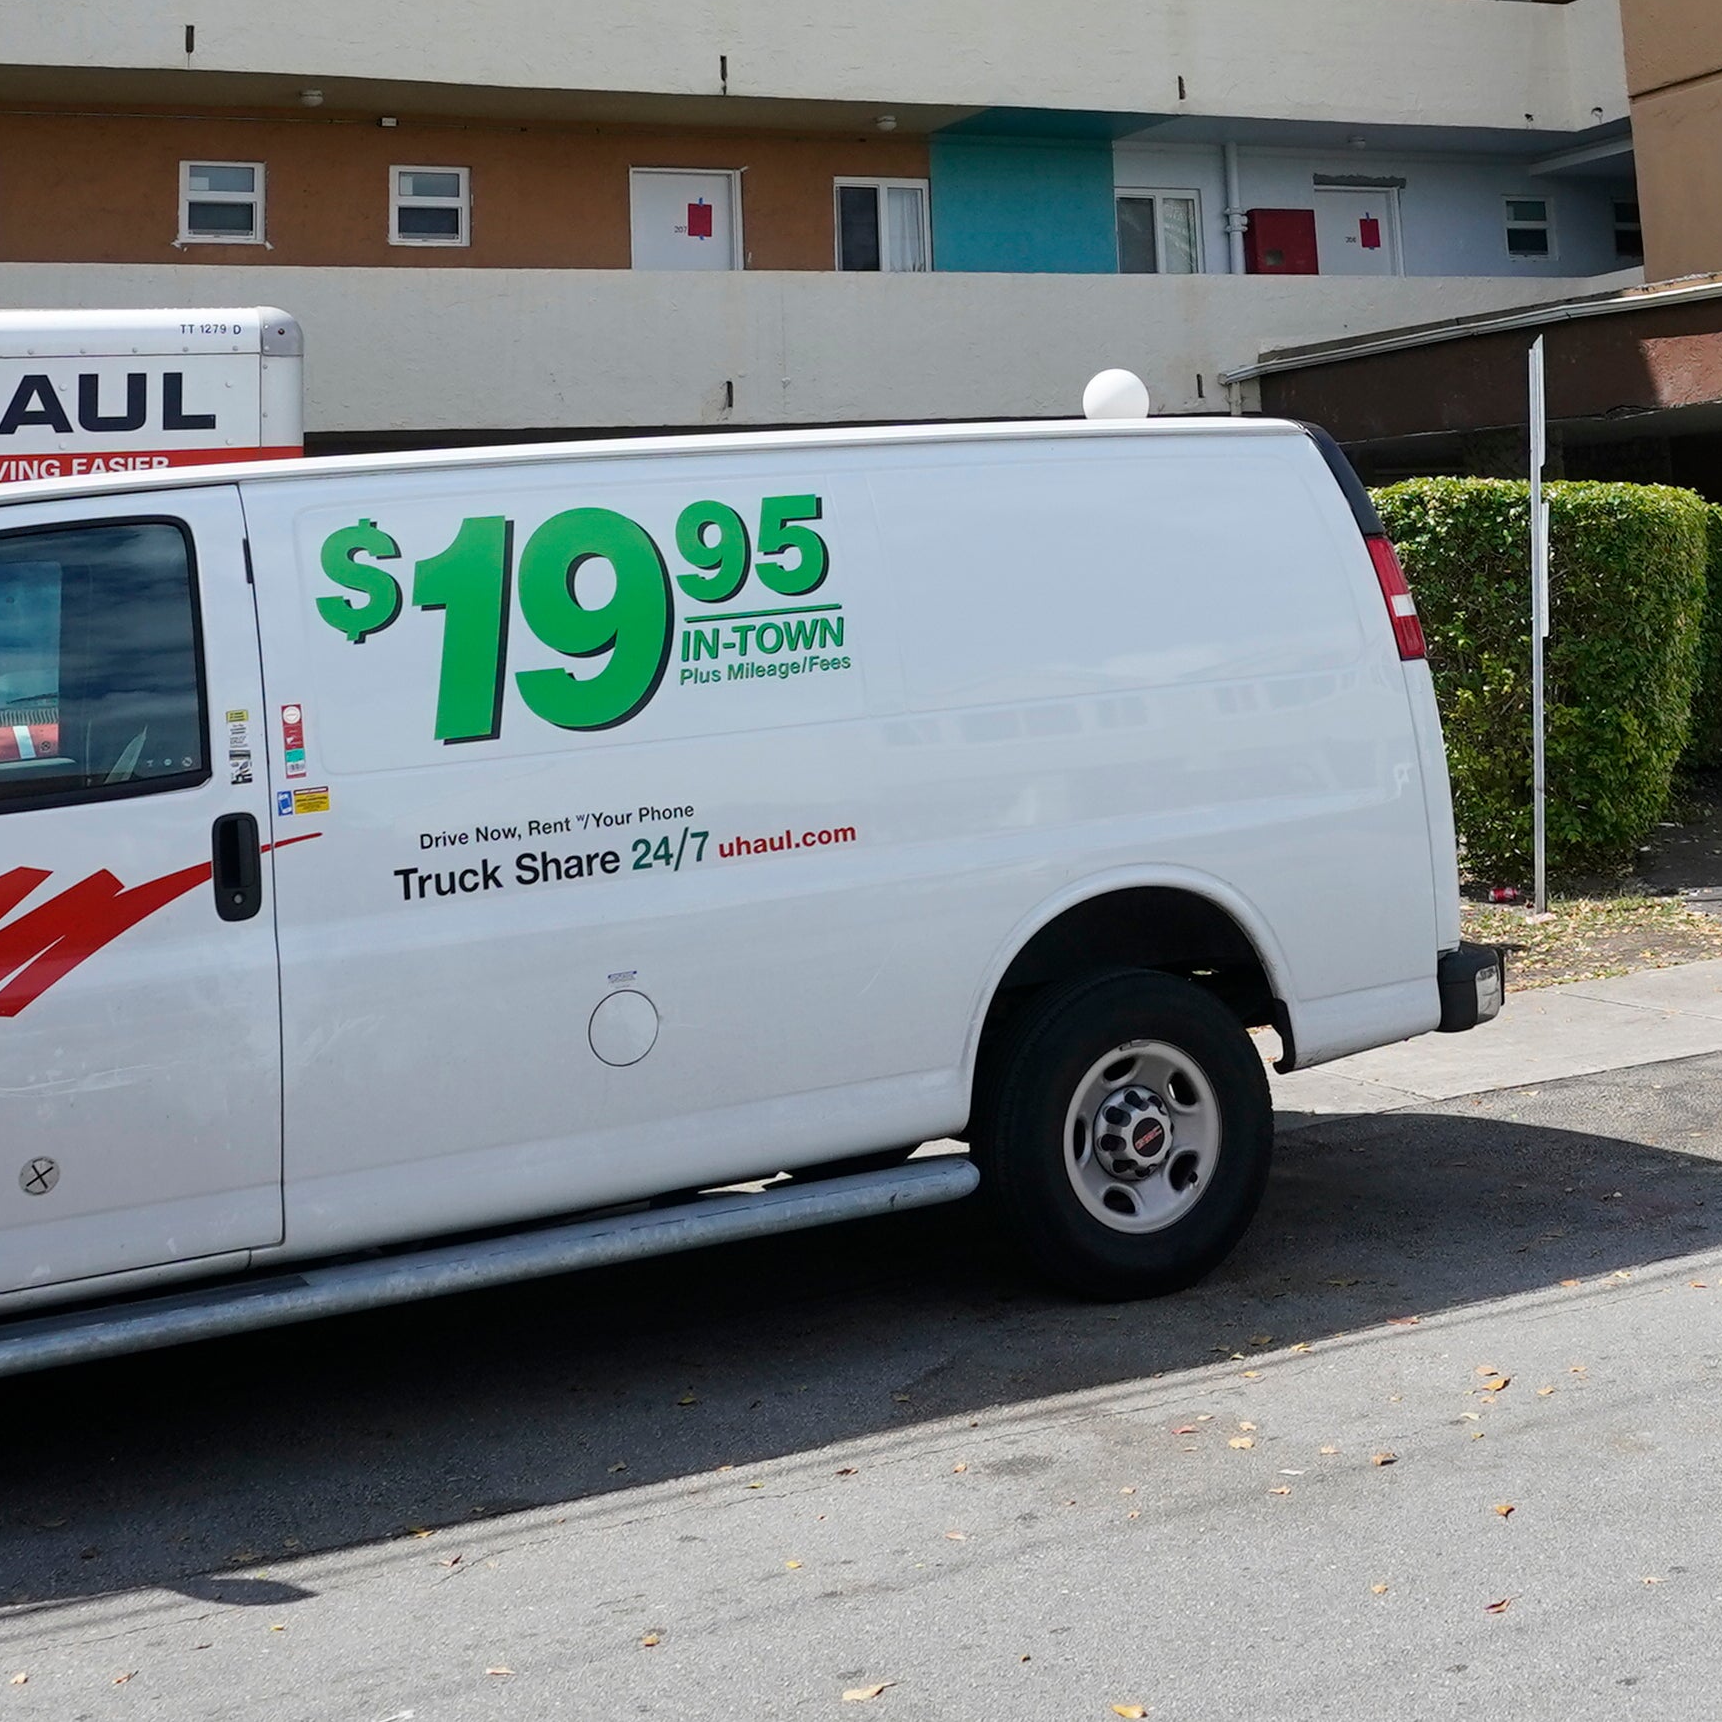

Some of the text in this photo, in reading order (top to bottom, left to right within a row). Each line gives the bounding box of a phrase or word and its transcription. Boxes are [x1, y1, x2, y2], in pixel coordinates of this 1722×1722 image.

[180, 323, 242, 335] TT 1279 D
[681, 616, 844, 662] IN-TOWN
[680, 655, 851, 686] Plus Mileage/Fees
[420, 829, 469, 850] Drive
[475, 826, 522, 843] Now,
[528, 816, 571, 837] Rent
[638, 803, 694, 823] Phone
[394, 824, 856, 900] Truck Share 24/7 uhaul.com
